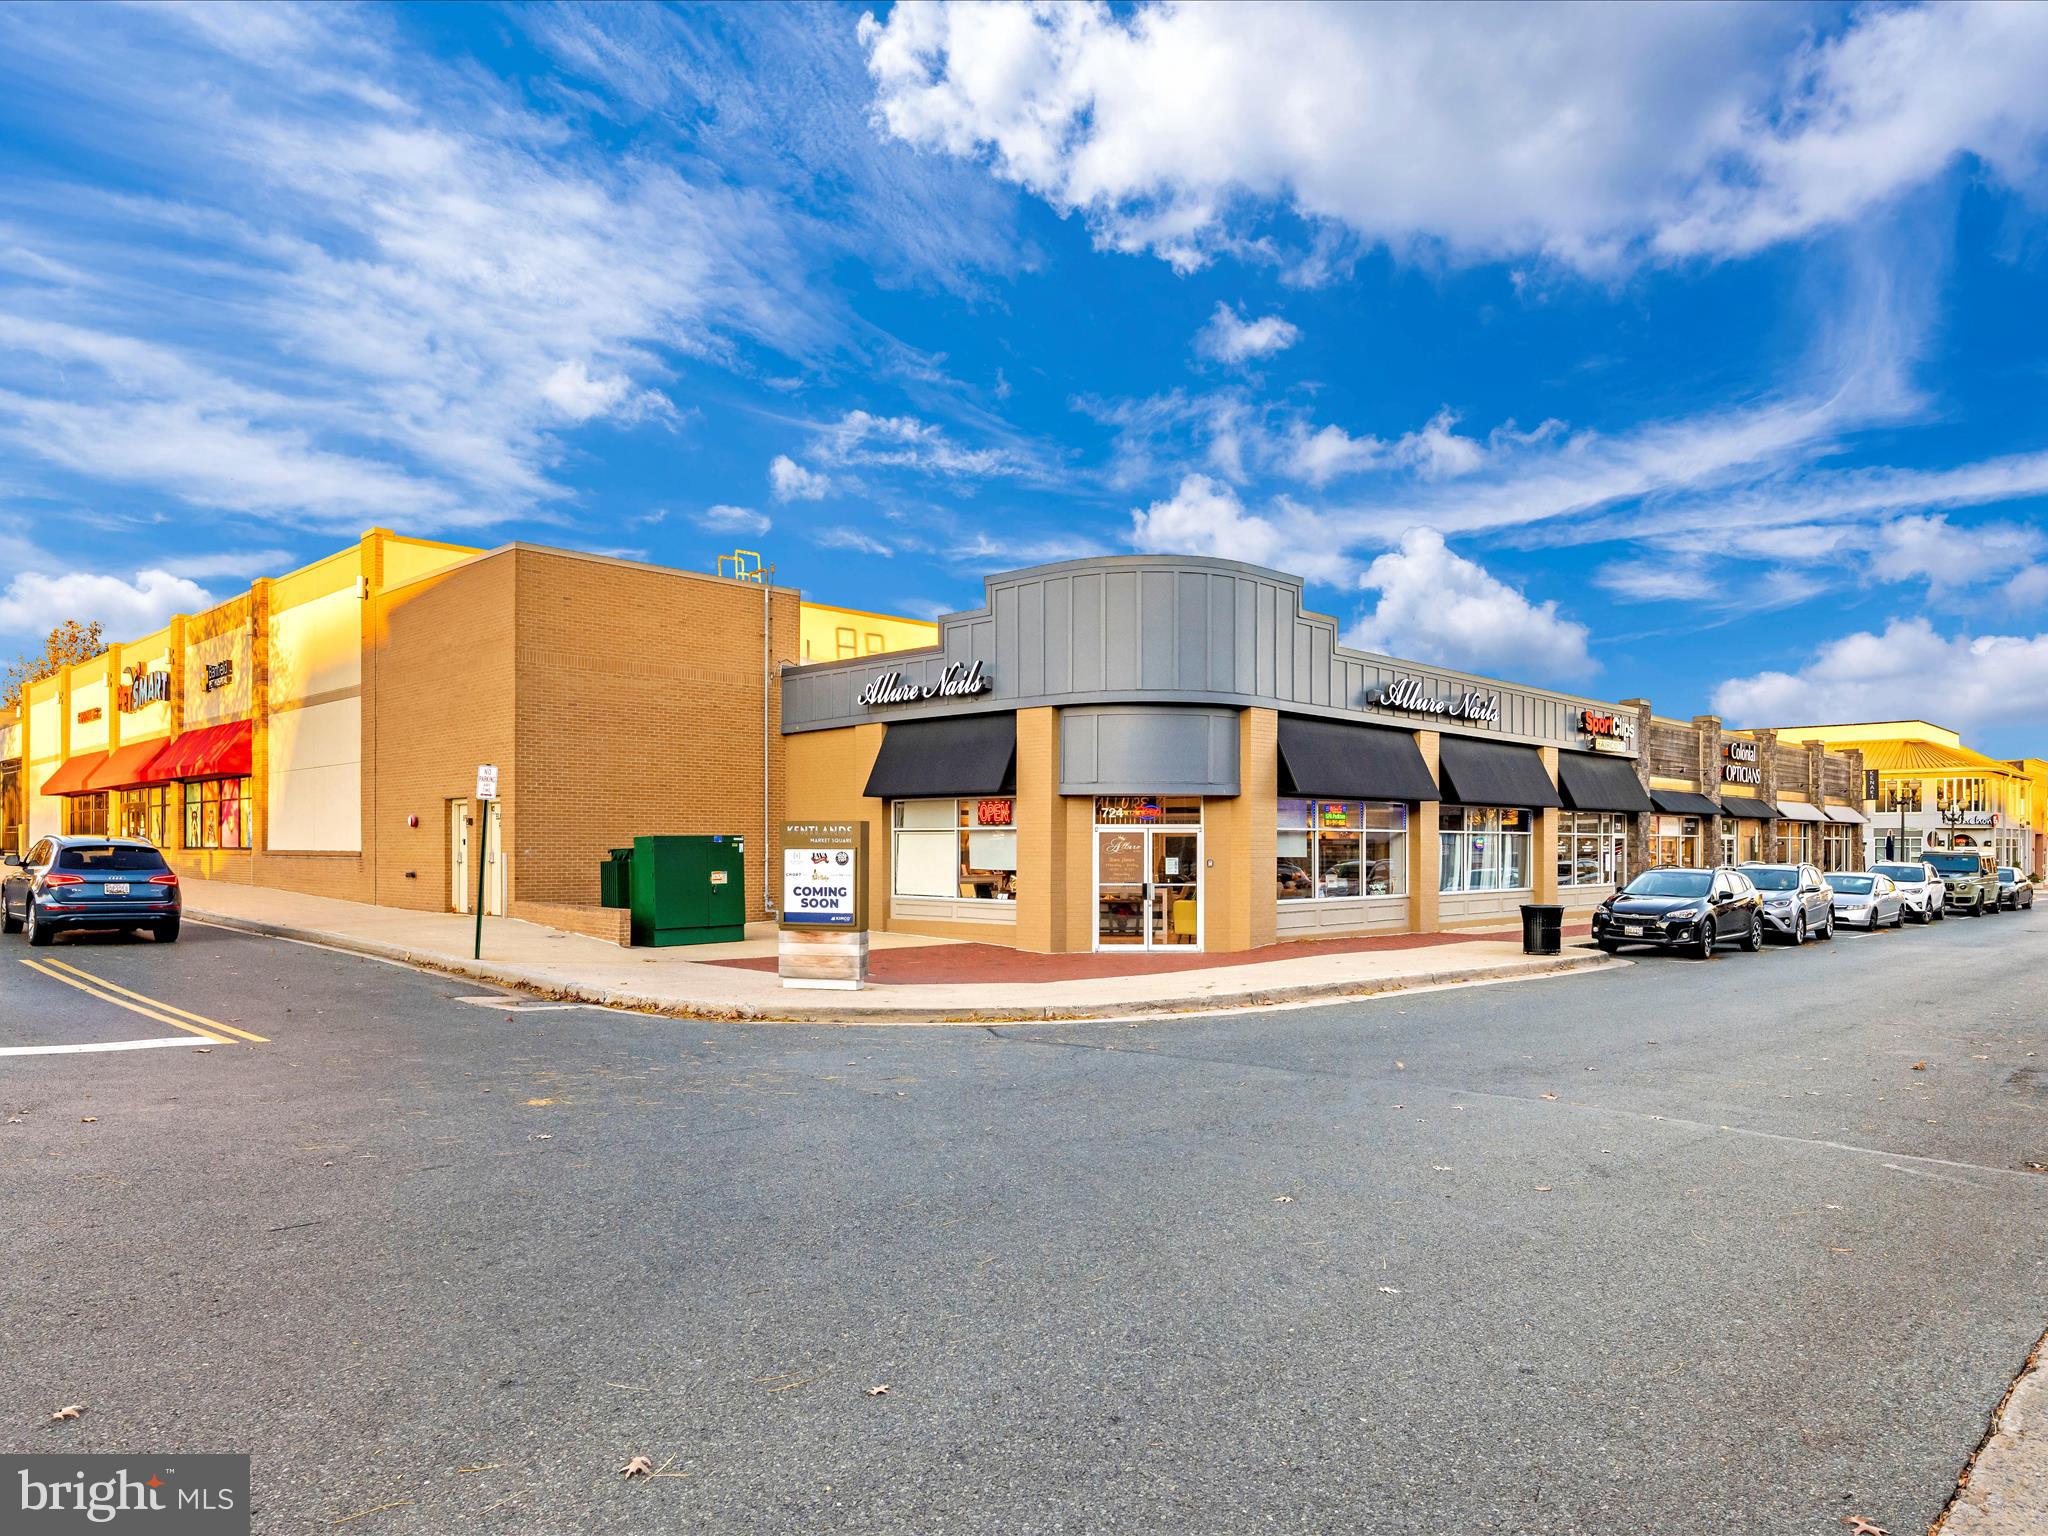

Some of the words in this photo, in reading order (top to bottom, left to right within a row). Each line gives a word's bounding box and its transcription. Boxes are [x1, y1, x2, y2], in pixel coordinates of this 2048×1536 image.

[857, 671, 919, 705] Allure
[922, 660, 982, 698] Nails
[1380, 678, 1445, 714] Allure
[1448, 692, 1500, 722] Nails
[1731, 742, 1756, 761] Colonial
[1726, 765, 1760, 784] OPTICIANS
[980, 803, 1009, 822] OPEN
[1101, 807, 1124, 818] 724
[793, 886, 847, 897] COMING
[801, 898, 839, 908] SOON
